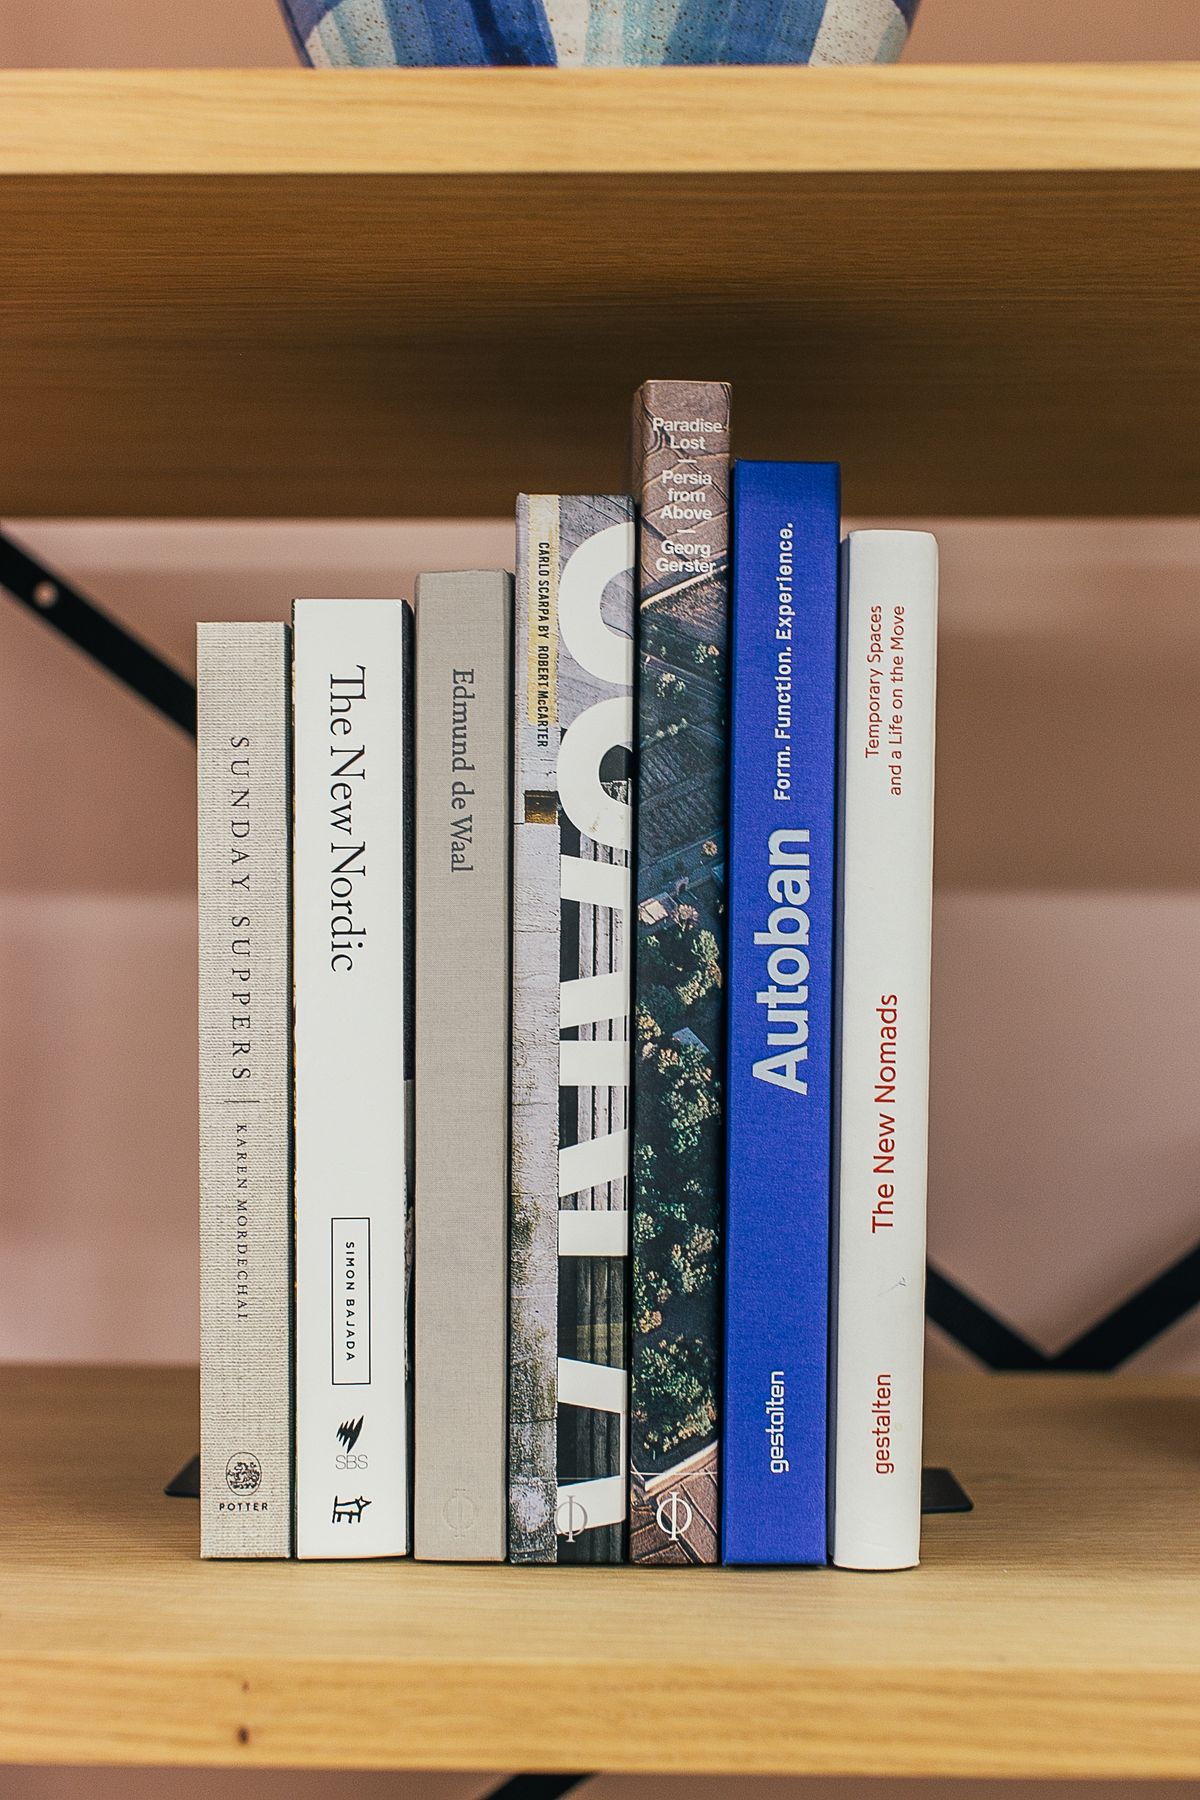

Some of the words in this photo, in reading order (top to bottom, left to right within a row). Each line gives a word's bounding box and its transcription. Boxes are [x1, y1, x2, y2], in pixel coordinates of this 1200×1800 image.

[652, 416, 723, 434] Paradise
[669, 433, 707, 451] Lost
[661, 469, 713, 485] Persia
[667, 487, 706, 503] from
[660, 504, 713, 520] Above
[538, 542, 550, 577] CARLO
[655, 557, 717, 574] Gerster
[660, 539, 711, 559] Georg
[537, 580, 550, 622] SCARPA
[775, 522, 796, 641] Experience.
[537, 625, 550, 639] BY
[866, 604, 884, 662] Spaces
[890, 606, 905, 651] Move
[537, 645, 550, 688] ROBERT
[889, 655, 904, 683] the
[329, 664, 367, 736] The
[774, 646, 792, 739] Function.
[863, 668, 884, 757] Temporary
[891, 688, 904, 709] on
[451, 668, 476, 773] Edmund
[537, 690, 549, 747] McCARTER
[888, 710, 904, 745] Life
[773, 745, 791, 801] Form.
[891, 749, 902, 759] a
[330, 744, 366, 836] New
[451, 781, 476, 810] de
[889, 764, 902, 795] and
[230, 736, 250, 892] SUNDAY
[450, 814, 474, 873] Waal
[330, 841, 367, 972] Nordic
[752, 829, 811, 1096] Autoban
[231, 916, 252, 1079] SUPPERS
[873, 994, 898, 1103] Nomads
[236, 1123, 248, 1189] KAREN
[872, 1112, 896, 1174] New
[871, 1183, 895, 1233] The
[236, 1199, 249, 1319] MORDECHAI
[345, 1241, 355, 1290] SIMON
[346, 1298, 356, 1361] BAJADA
[765, 1371, 790, 1474] gestalten
[872, 1373, 895, 1475] gestalten
[335, 1454, 369, 1470] SBS
[219, 1502, 268, 1512] POTTER
